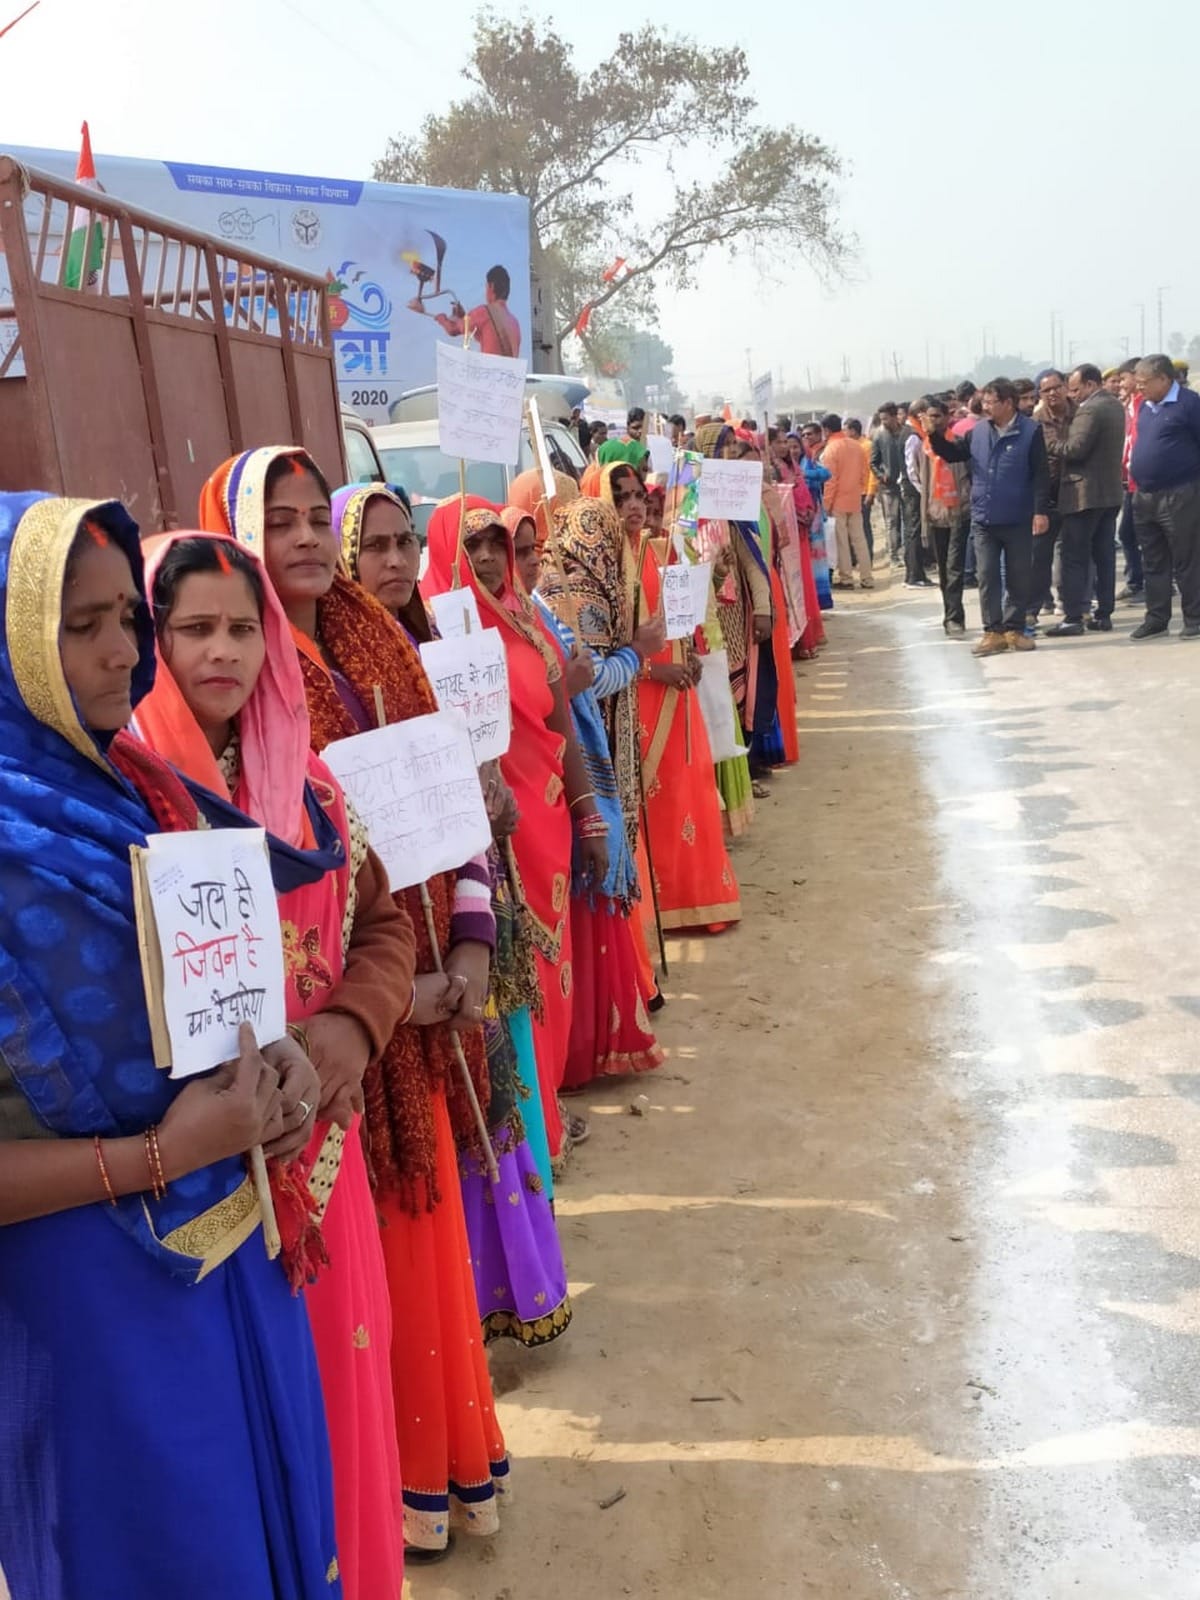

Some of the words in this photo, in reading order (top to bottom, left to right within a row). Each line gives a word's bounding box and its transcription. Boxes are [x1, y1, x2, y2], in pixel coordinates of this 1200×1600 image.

[352, 390, 388, 406] 2020
[178, 881, 229, 930] जल
[233, 867, 257, 919] ही
[172, 931, 239, 987] जिवन
[241, 924, 264, 968] है
